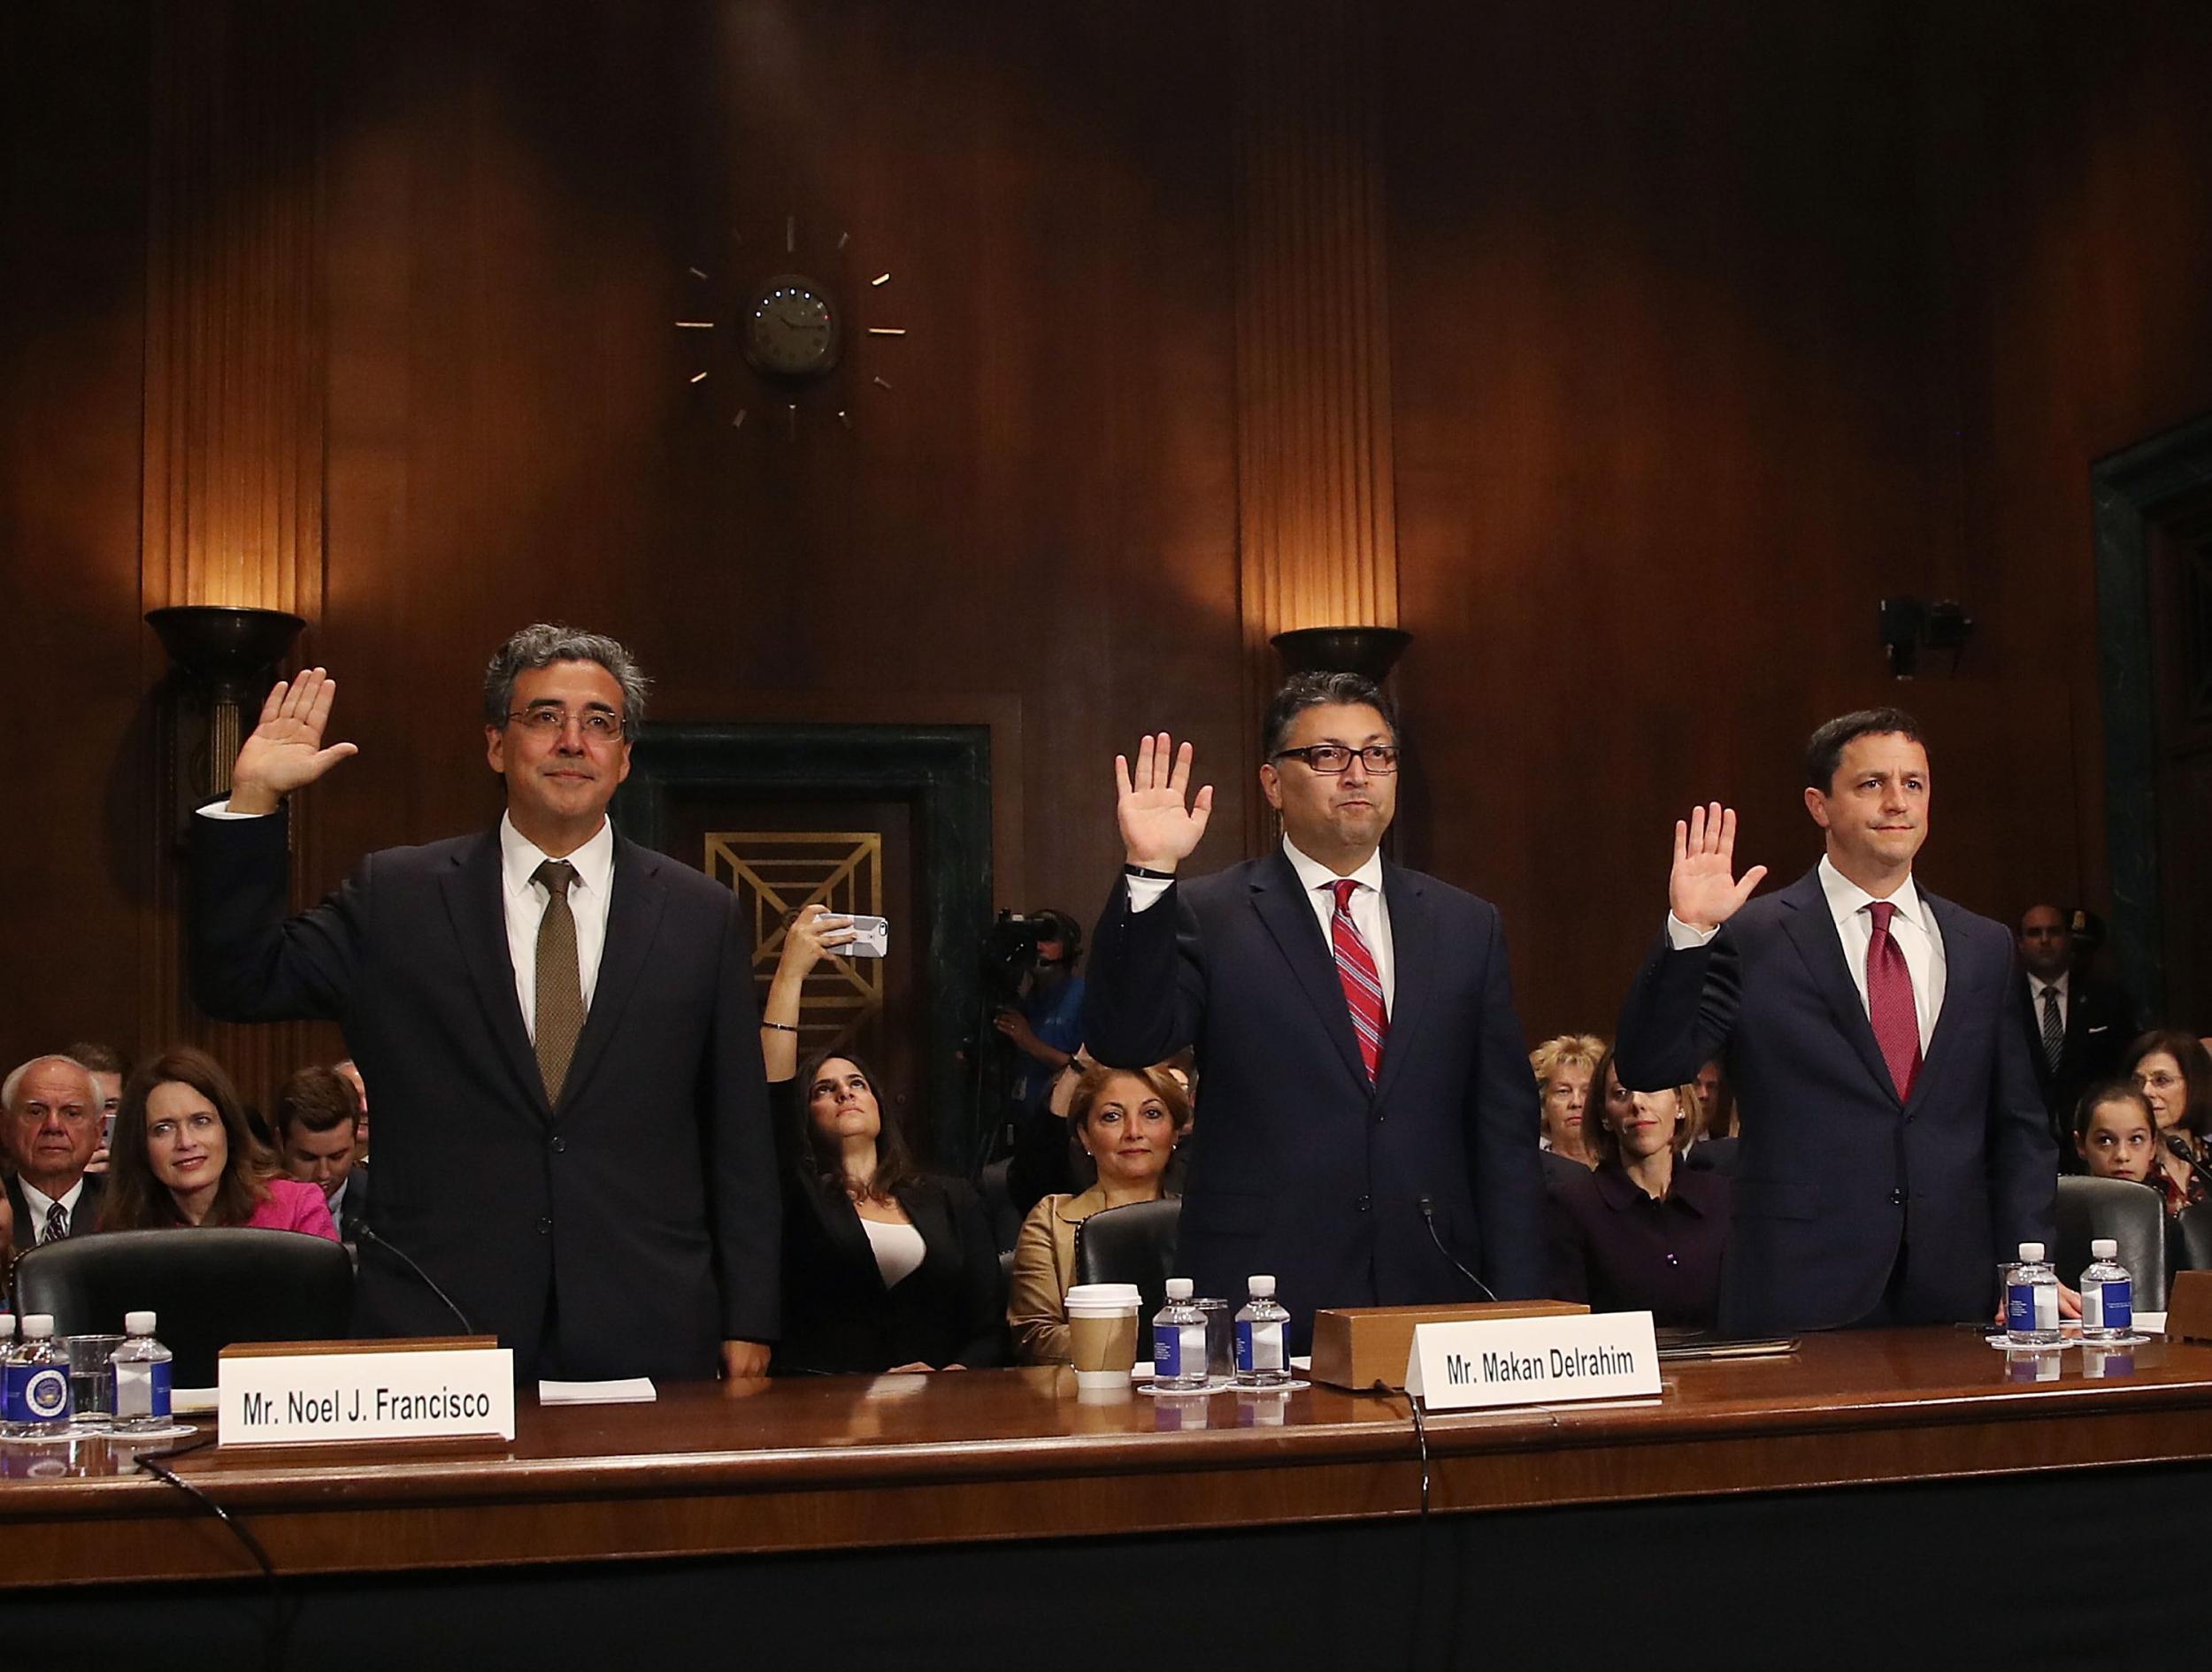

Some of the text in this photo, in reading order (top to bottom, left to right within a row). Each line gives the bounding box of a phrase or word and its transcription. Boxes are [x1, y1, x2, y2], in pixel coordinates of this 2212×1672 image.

[1447, 1345, 1634, 1384] Mr. Makan Delrahim
[243, 1385, 489, 1425] Mr. Noel J. Francisco
